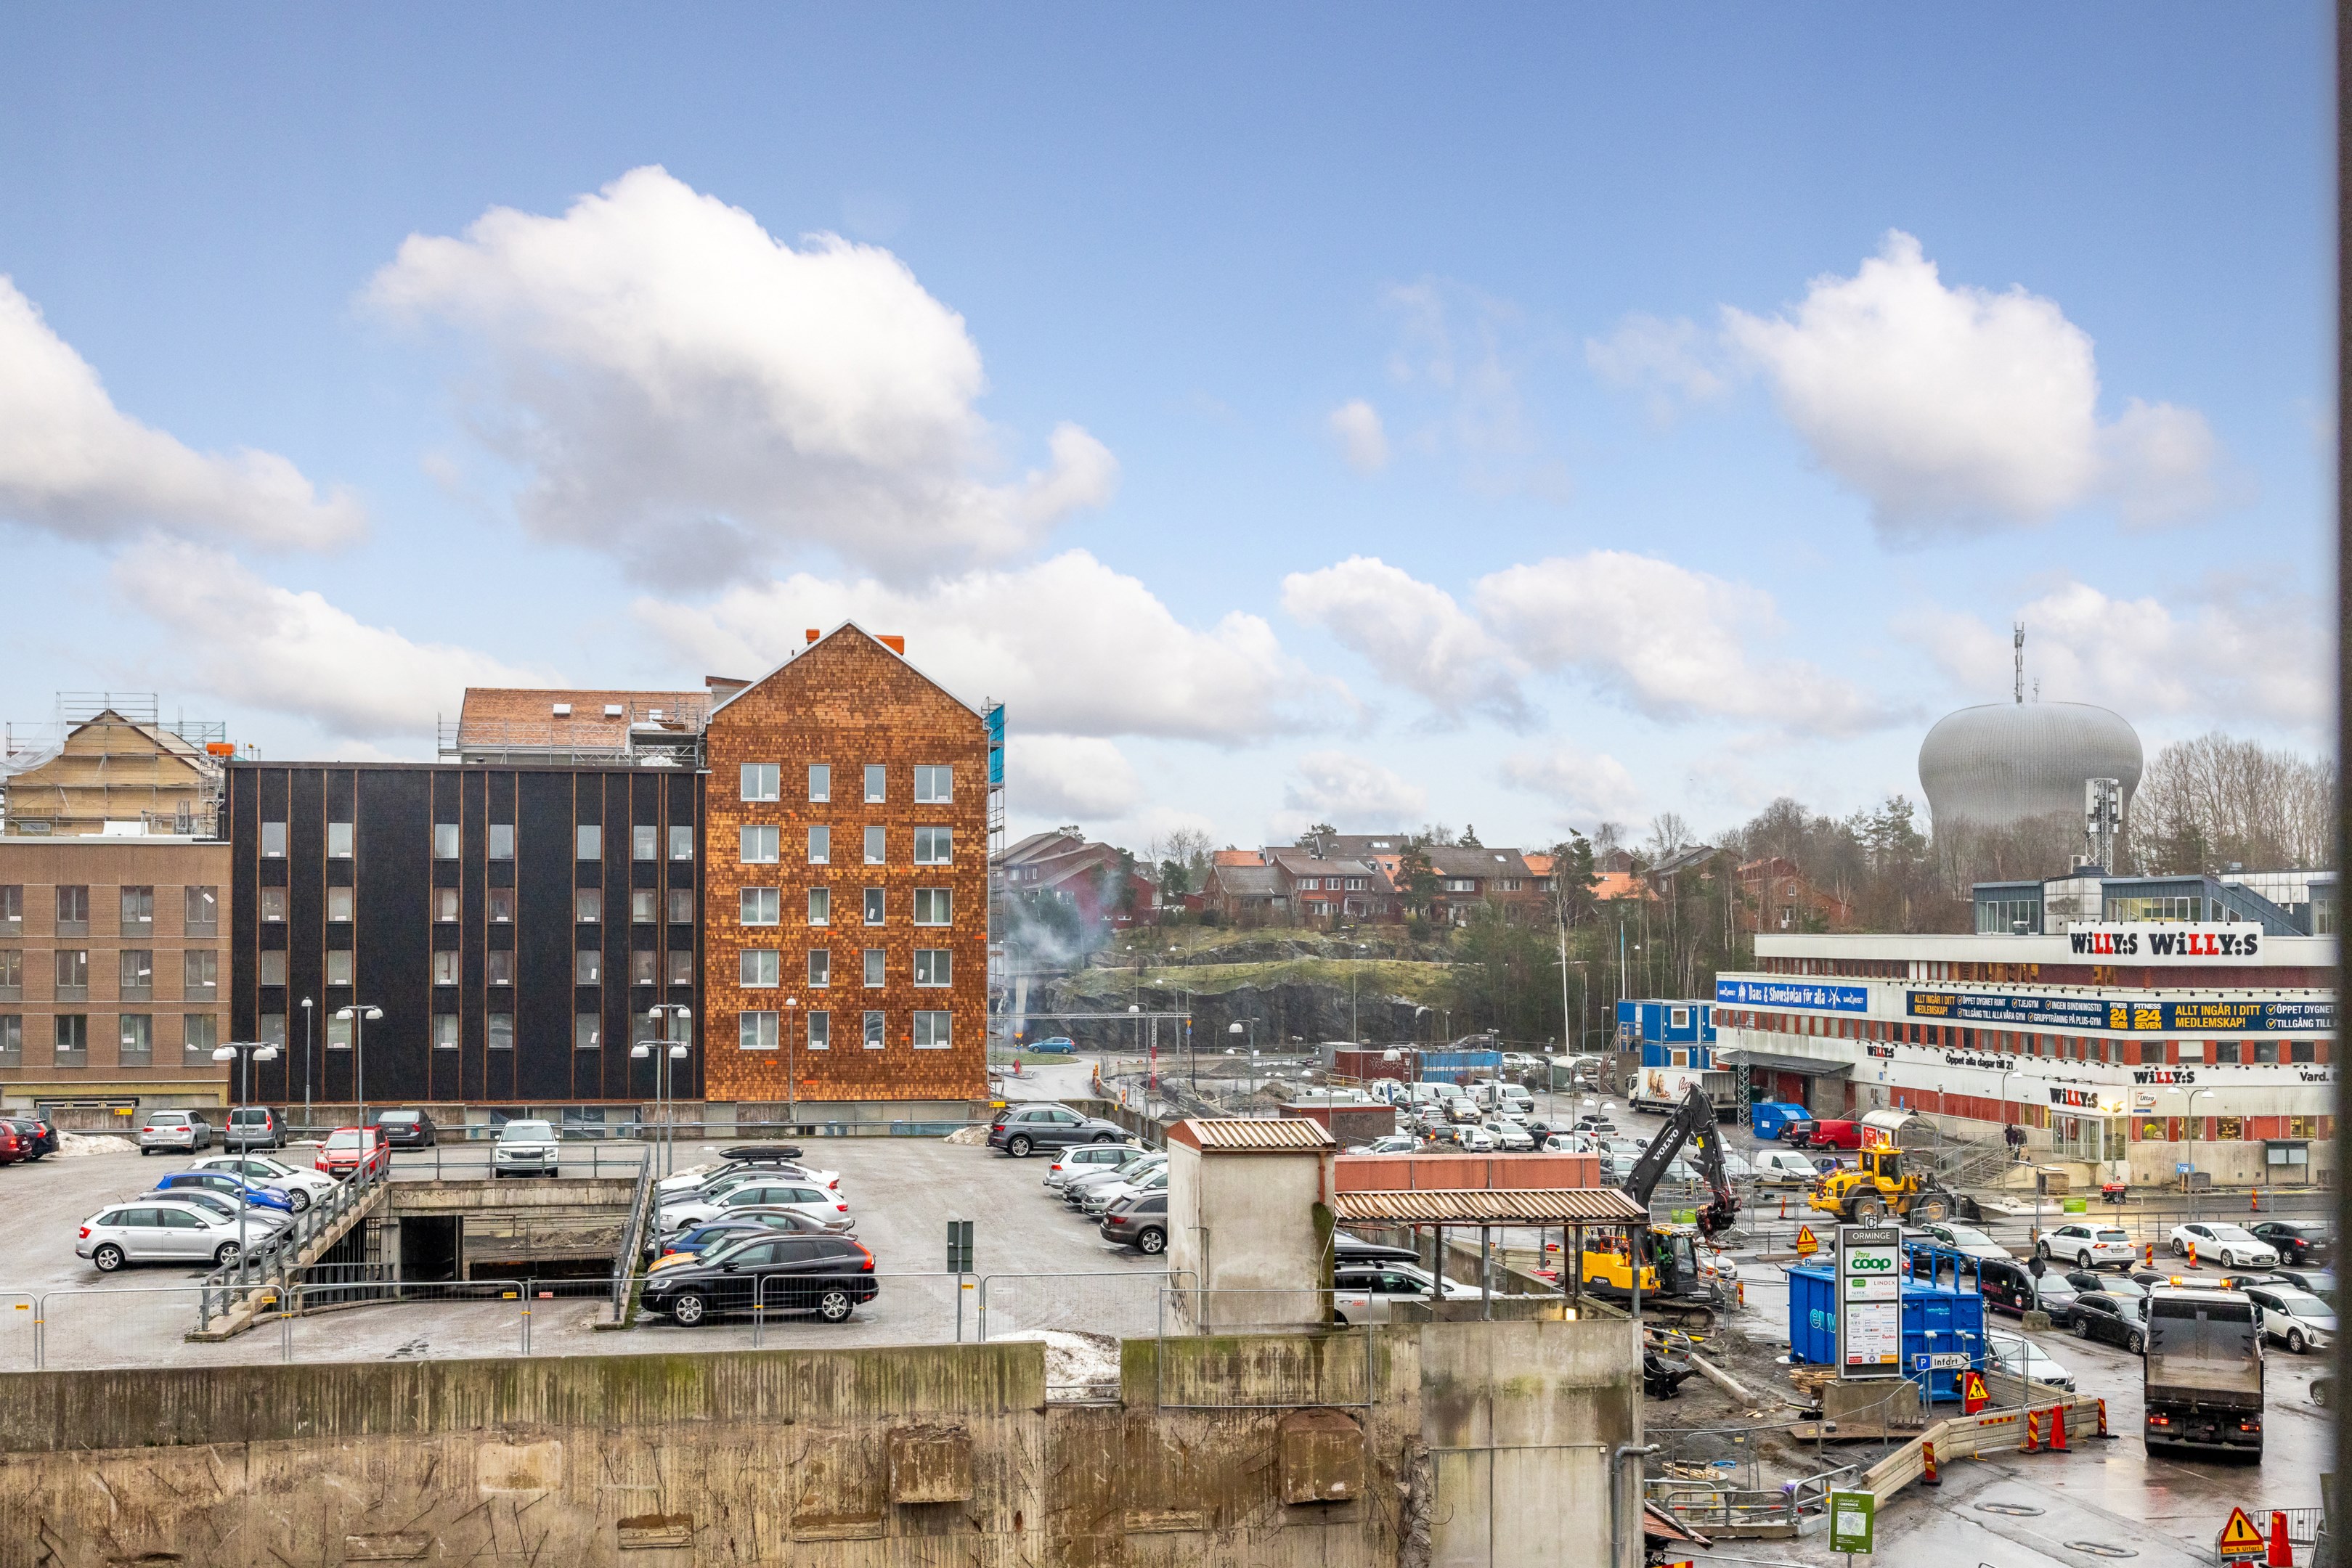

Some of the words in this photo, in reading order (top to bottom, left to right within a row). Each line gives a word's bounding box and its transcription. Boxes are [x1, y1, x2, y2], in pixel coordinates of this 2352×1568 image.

[1749, 984, 1762, 1000] Dans
[1763, 987, 1768, 1003] &
[1769, 986, 1802, 1004] Showskolan
[1803, 988, 1812, 1004] för
[1814, 988, 1825, 1005] alla
[1914, 995, 1925, 1004] ALLT
[1926, 993, 1941, 1005] INGÅR
[1942, 996, 1944, 1005] I
[1945, 996, 1955, 1005] DITT
[1962, 995, 1975, 1005] ÖPPET
[1977, 997, 1993, 1006] DYGNET
[1994, 998, 2006, 1007] RUNT
[2018, 1000, 2039, 1008] TJEJGYM
[2052, 1001, 2066, 1010] INGEN
[2067, 1003, 2102, 1012] BINDNINGSTID
[1914, 1005, 1948, 1015] MEDLEMSKAP!
[1963, 1008, 1982, 1018] TILLGÅNG
[1992, 1010, 2002, 1019] ALLA
[2003, 1010, 2015, 1020] VÅRA
[2109, 1008, 2128, 1021] 24
[2175, 1005, 2198, 1016] ALLT
[2201, 1003, 2231, 1016] INGÅR
[2233, 1005, 2237, 1016] I
[2239, 1005, 2261, 1016] DITT
[2276, 1003, 2303, 1014] ÖPPET
[2304, 1005, 2334, 1013] DYGNET
[2034, 1013, 2068, 1024] GRUPPTRÄNING
[2069, 1013, 2075, 1024] PÅ
[2076, 1016, 2101, 1026] PLUS-GYM
[2134, 1009, 2162, 1021] 24
[2176, 1017, 2246, 1028] MEDLEMSKAP!
[2276, 1017, 2314, 1028] TILLGÅNG
[1946, 1053, 1964, 1065] Öppet
[1966, 1057, 1976, 1066] alla
[1977, 1058, 1995, 1069] dagar
[1996, 1058, 2005, 1069] till
[2006, 1061, 2014, 1070] 21
[2300, 1071, 2329, 1082] Vard.
[1653, 1129, 1679, 1161] VOLVO
[1852, 1258, 1892, 1271] coop
[1921, 1358, 1926, 1367] P
